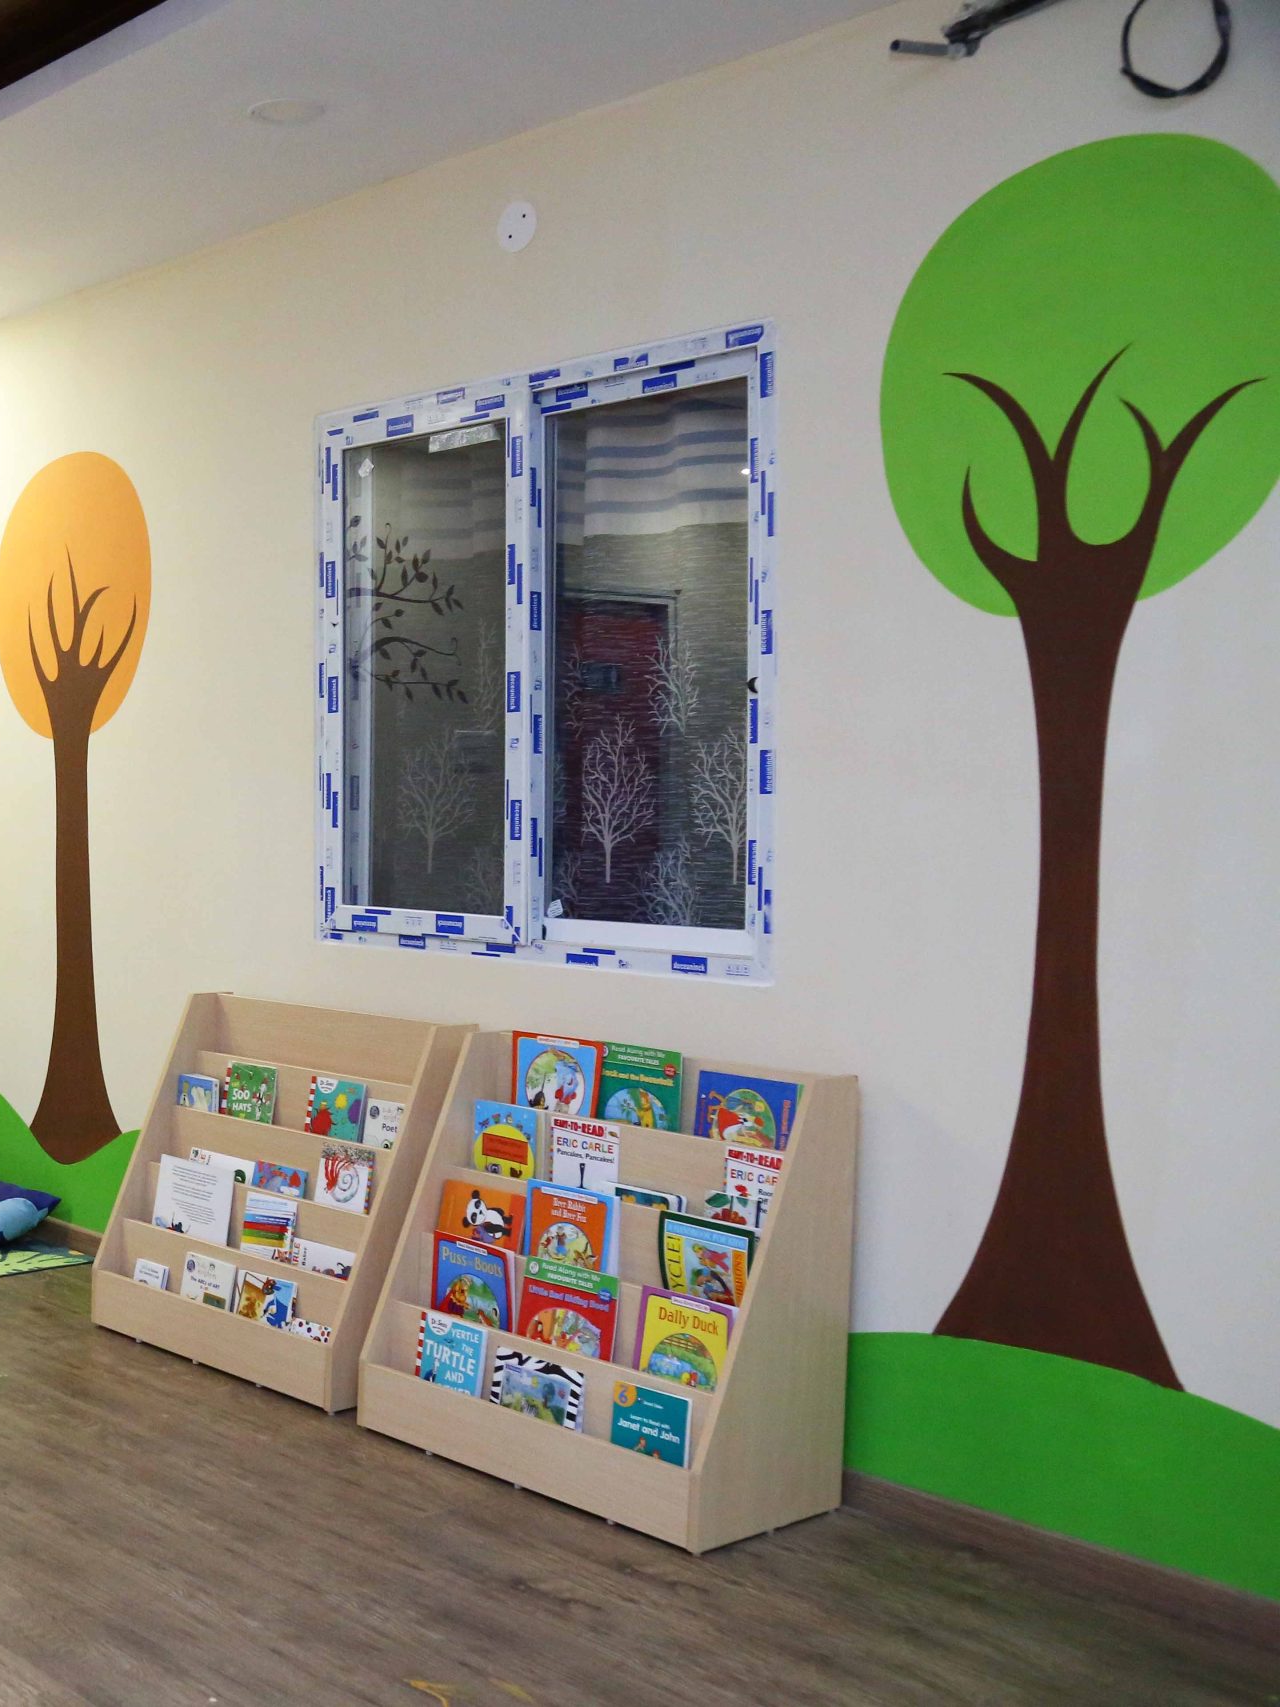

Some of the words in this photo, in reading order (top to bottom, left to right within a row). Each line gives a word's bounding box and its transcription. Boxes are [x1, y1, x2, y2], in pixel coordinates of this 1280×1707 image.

[232, 1088, 250, 1100] 500
[232, 1102, 252, 1112] HATS
[557, 1137, 578, 1148] ERIC
[581, 1141, 614, 1154] CARLE
[730, 1169, 753, 1182] ERIC
[442, 1246, 466, 1267] Puss
[475, 1257, 503, 1278] Boots
[666, 1235, 684, 1288] YCLE!
[558, 1264, 576, 1277] Along
[692, 1315, 719, 1335] Duck
[451, 1328, 480, 1343] YERTLE
[425, 1339, 475, 1376] TURTLE
[444, 1370, 464, 1383] AND
[617, 1417, 640, 1431] Janet
[641, 1426, 659, 1437] and
[659, 1431, 680, 1444] John
